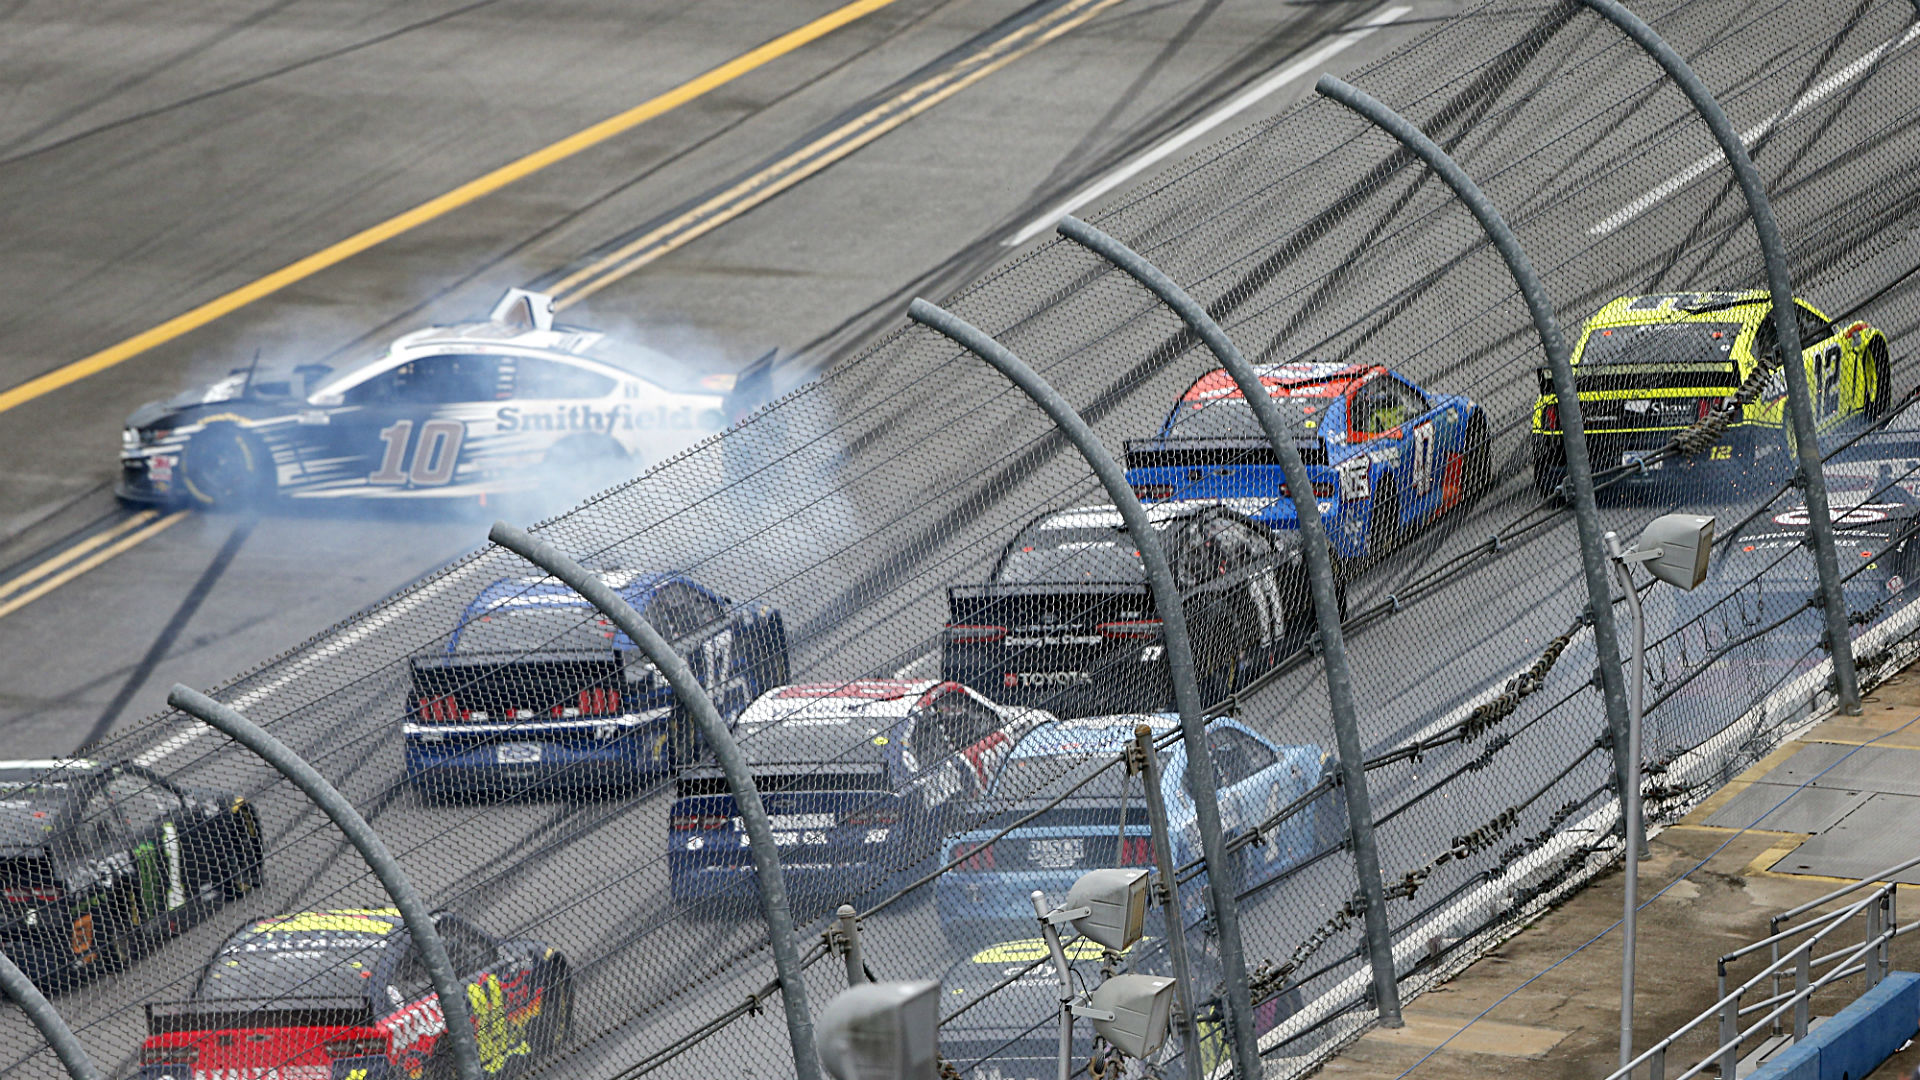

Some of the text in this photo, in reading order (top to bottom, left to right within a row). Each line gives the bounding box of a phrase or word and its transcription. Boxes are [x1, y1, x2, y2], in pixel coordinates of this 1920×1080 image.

[1813, 343, 1842, 423] 12
[496, 404, 692, 433] Smithfield
[369, 420, 465, 484] 10
[1710, 446, 1733, 459] 12
[1020, 672, 1092, 686] TOYOTA
